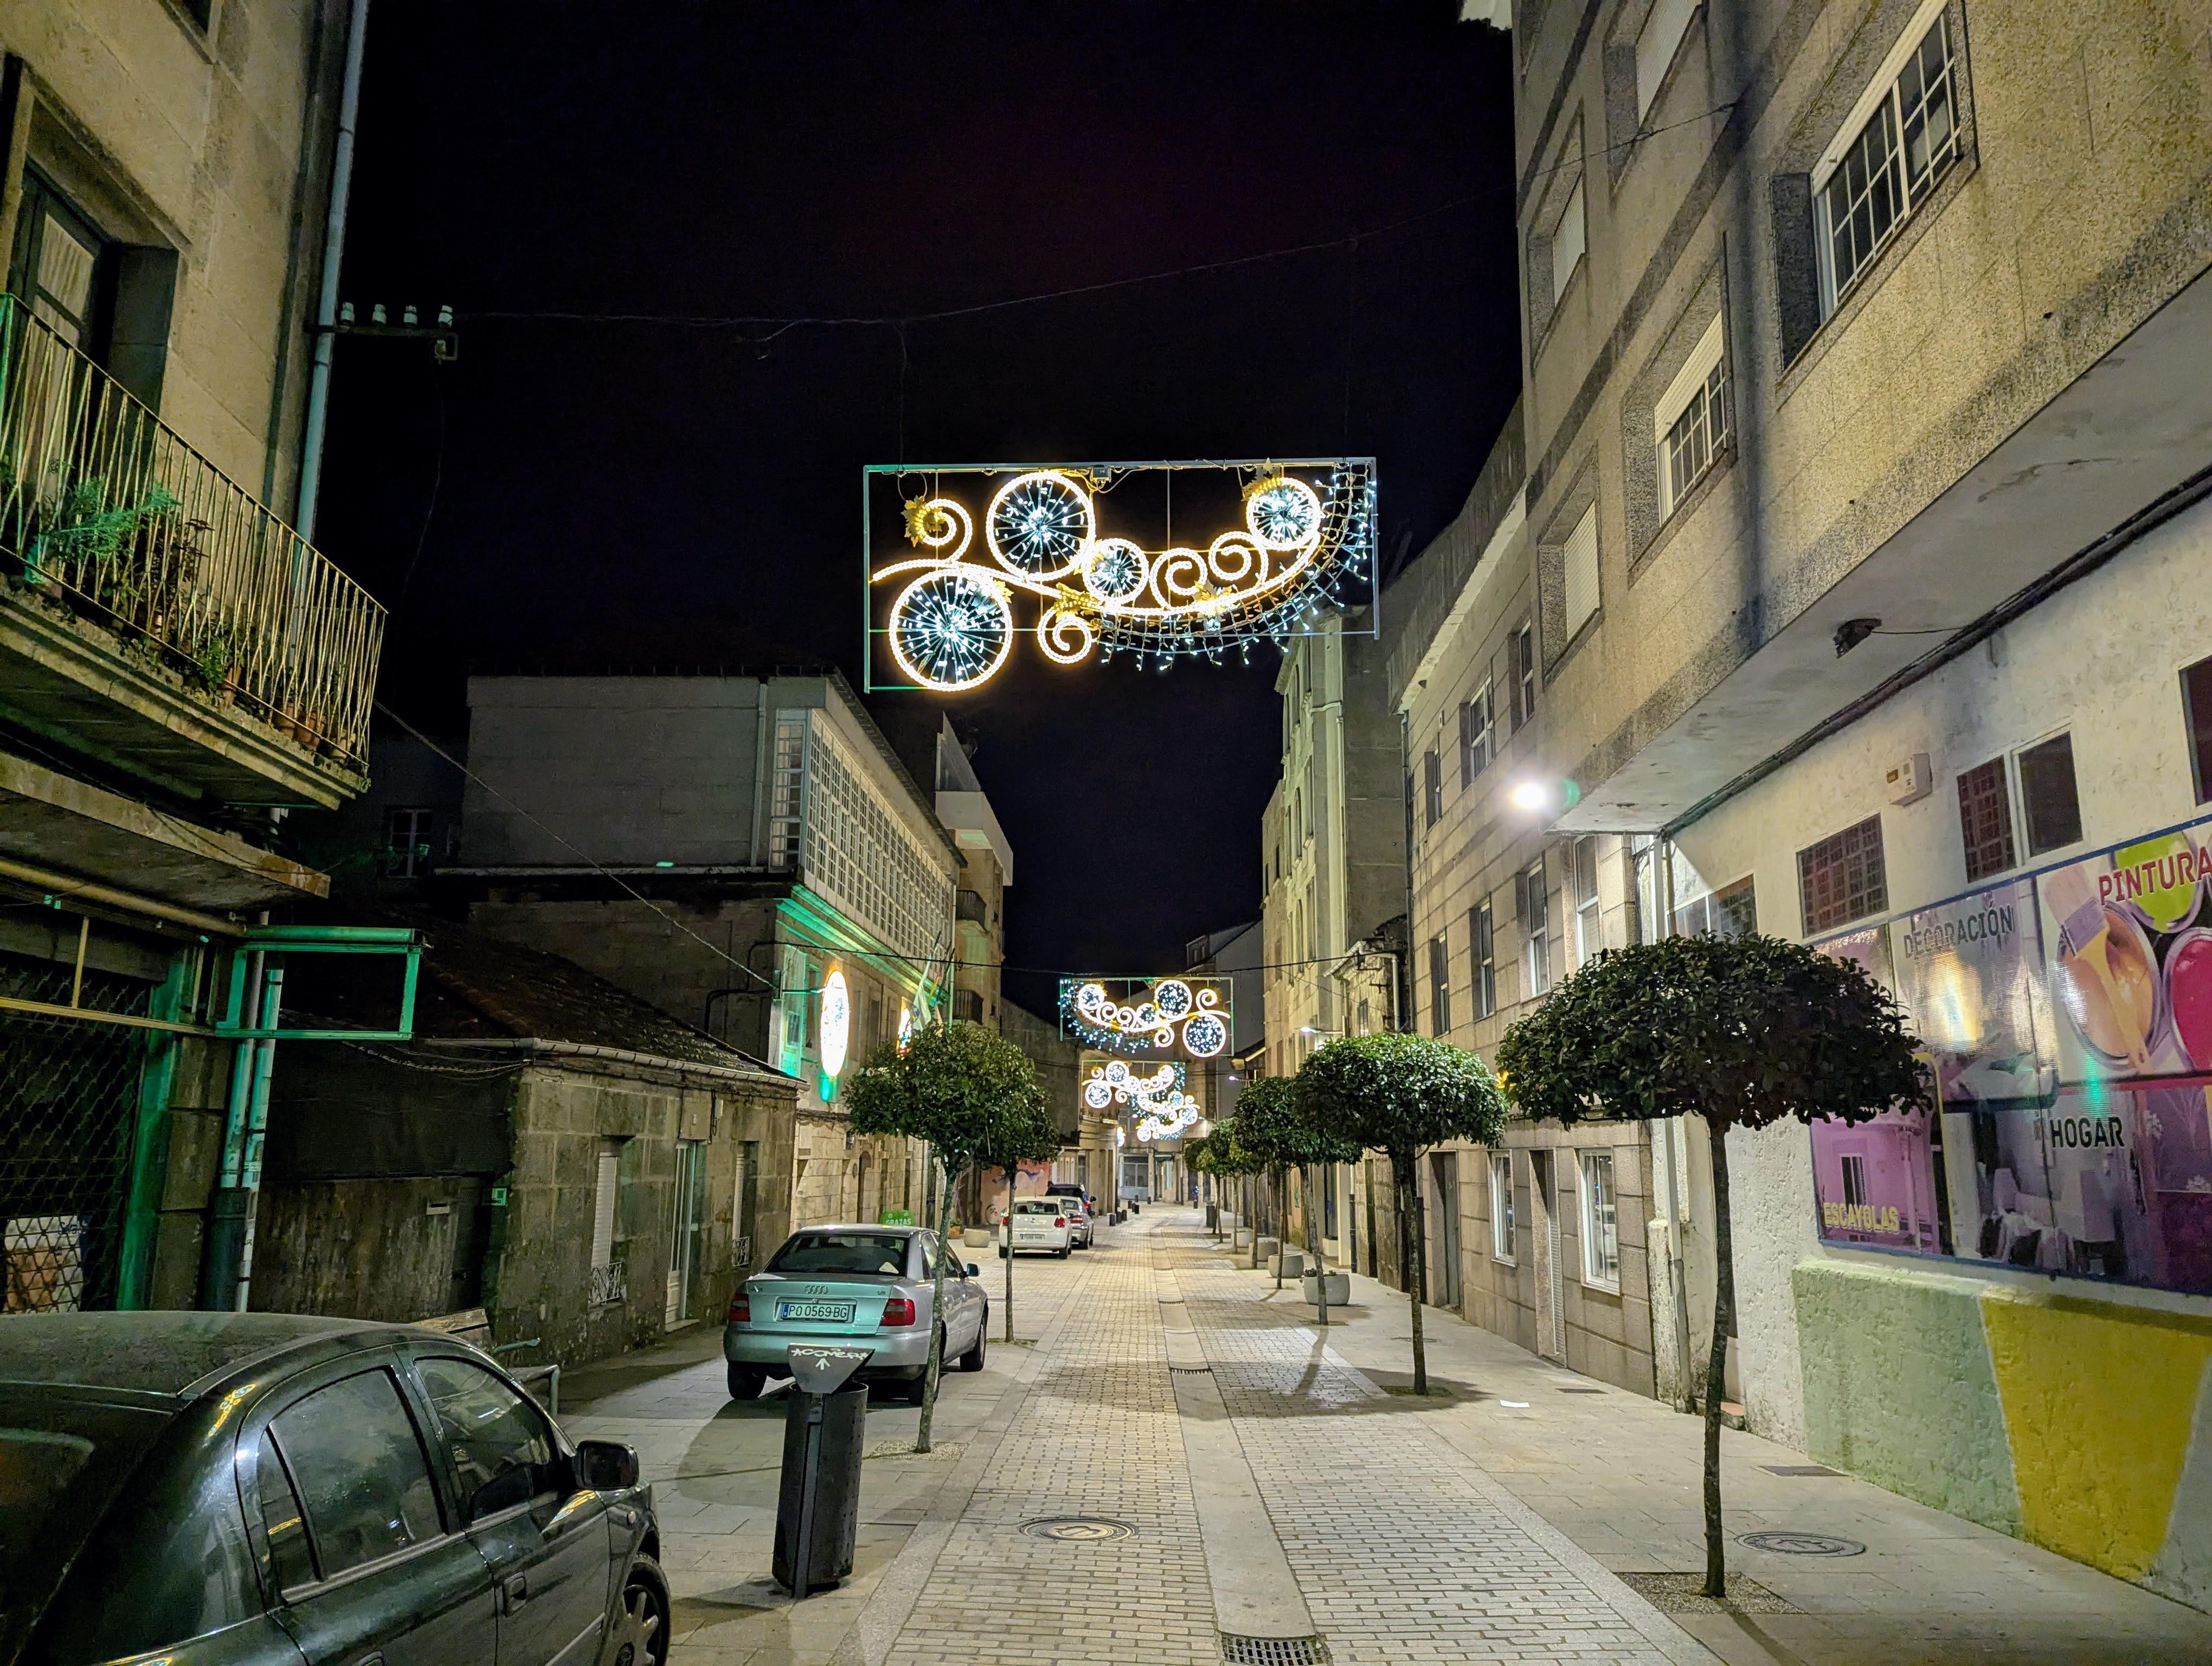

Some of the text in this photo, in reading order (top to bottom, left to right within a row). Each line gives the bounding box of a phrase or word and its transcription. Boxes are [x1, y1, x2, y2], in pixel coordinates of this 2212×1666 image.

[2098, 846, 2212, 906] PINTURA
[1903, 900, 2015, 959] DECORACIÓN
[2049, 1116, 2125, 1148] HOGAR
[1823, 1202, 1900, 1234] ESCAYOLAS
[788, 1305, 802, 1316] PO
